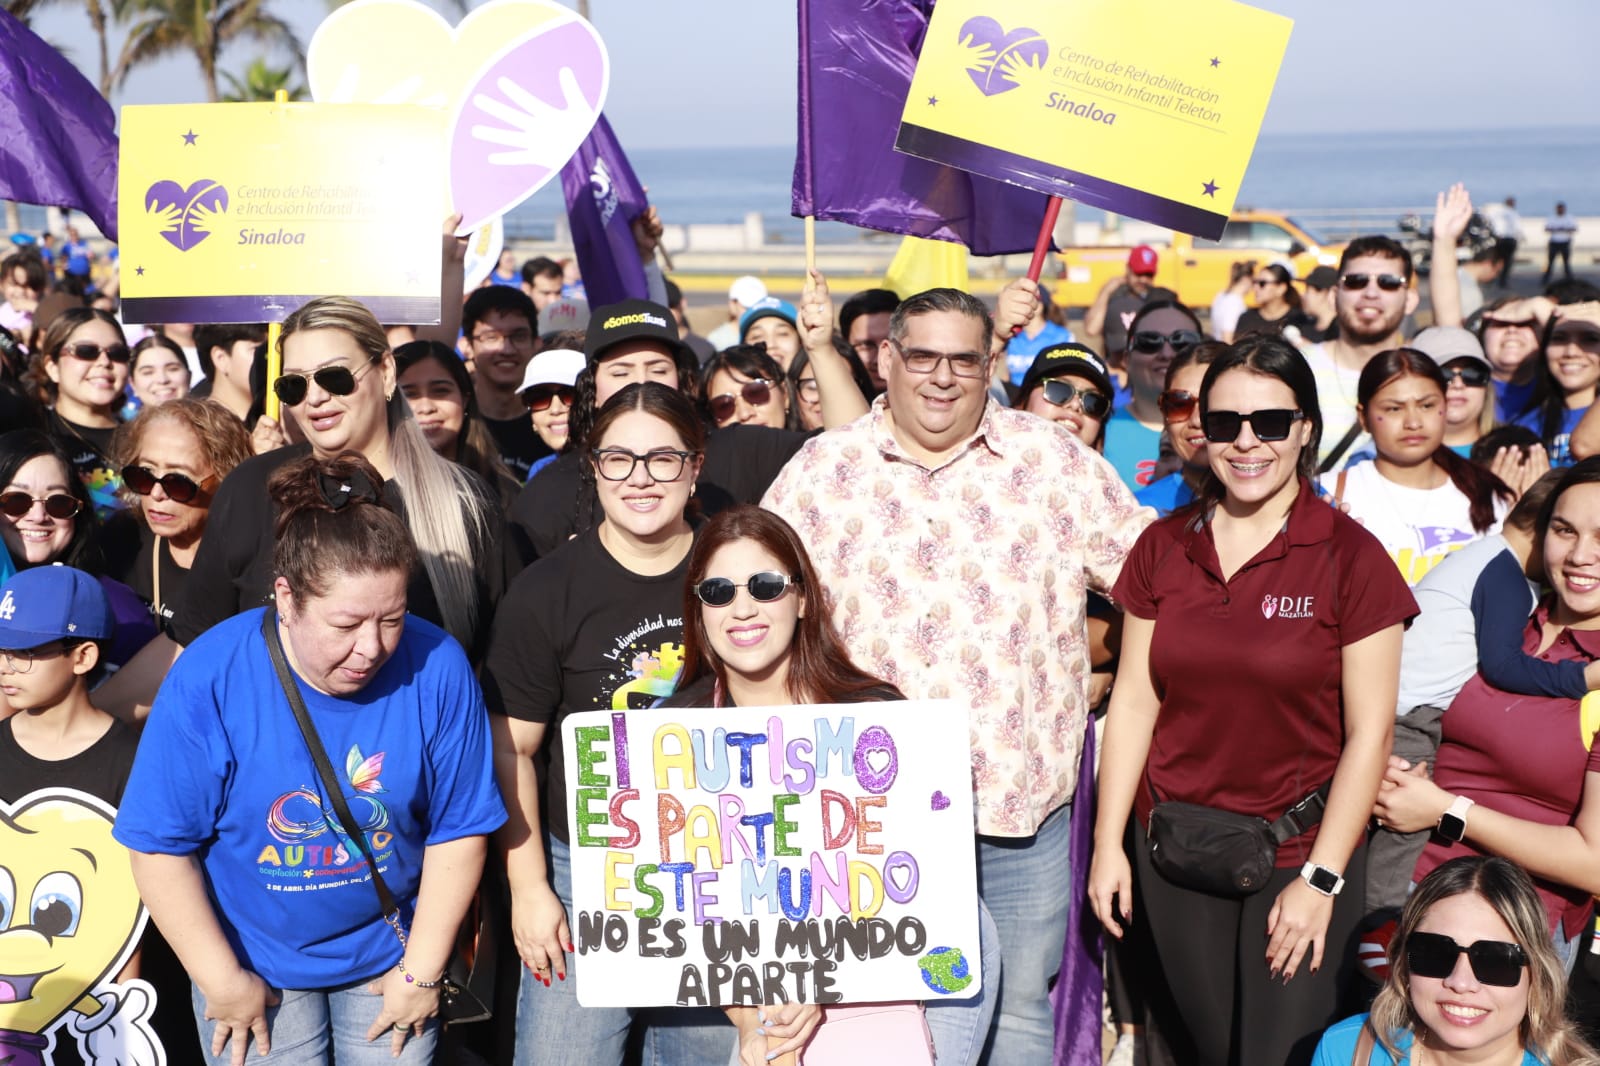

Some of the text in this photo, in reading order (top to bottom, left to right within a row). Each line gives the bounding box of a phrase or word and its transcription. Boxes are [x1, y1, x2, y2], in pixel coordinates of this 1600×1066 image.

[1052, 65, 1222, 124] e Inclusión Infantil Teletón
[1058, 45, 1220, 105] Centro de Rehabilitación
[1044, 91, 1117, 126] Sinaloa
[236, 205, 245, 216] e
[246, 201, 306, 216] Inclusión
[306, 201, 353, 216] Infantil
[237, 185, 280, 199] Centro
[282, 185, 301, 199] de
[238, 228, 306, 246] Sinaloa
[1280, 596, 1315, 612] DIF
[603, 613, 684, 660] La diversidad nos
[652, 715, 898, 795] AUTISMO
[576, 788, 888, 869] ES PARTE DE
[305, 883, 317, 891] DÍA
[318, 879, 349, 890] MUNDIAL
[603, 850, 920, 926] ESTE MUNDO
[578, 911, 927, 963] NO ES UN MUNDO
[676, 959, 843, 1006] APARTE
